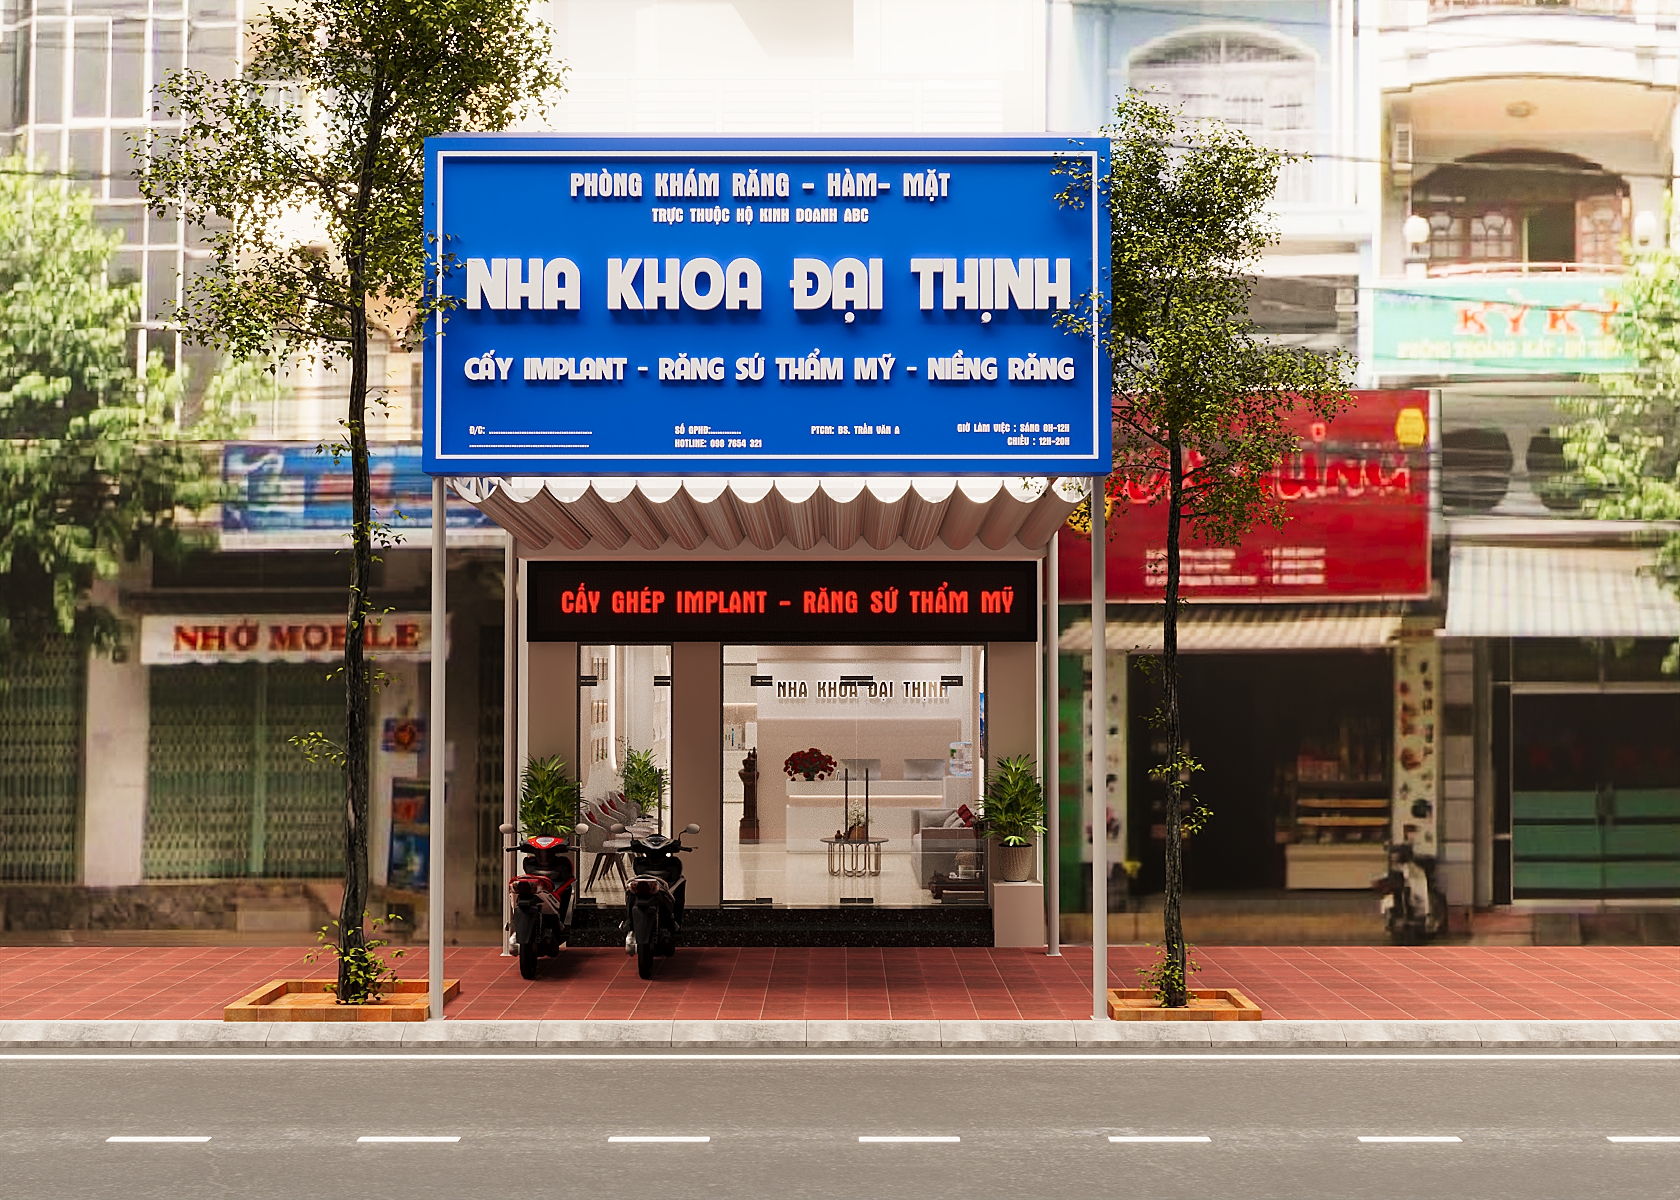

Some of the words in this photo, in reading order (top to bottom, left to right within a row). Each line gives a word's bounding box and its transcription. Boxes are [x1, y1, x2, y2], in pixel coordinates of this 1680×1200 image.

[570, 168, 643, 197] PHÒNG
[654, 168, 720, 197] KHÁM
[732, 168, 790, 197] RĂNG
[903, 168, 950, 202] MẶT
[652, 206, 684, 225] TRỰC
[690, 206, 730, 225] THUỘC
[736, 206, 754, 225] HỘ
[759, 207, 790, 223] KINH
[796, 207, 838, 223] DOANH
[844, 207, 869, 223] ABC
[464, 257, 581, 310] NHA
[607, 257, 762, 310] KHOA
[789, 257, 883, 324] ĐẠI
[910, 257, 1072, 324] THỊNH
[464, 349, 513, 381] CẤY
[523, 357, 628, 381] IMPLANT
[658, 352, 725, 381] RĂNG
[735, 352, 766, 381] SỨ
[775, 347, 844, 381] THẨM
[853, 352, 896, 381] MỸ
[927, 349, 998, 381] NIỀNG
[1007, 352, 1075, 381] RĂNG
[837, 425, 851, 435] BS.
[875, 424, 892, 435] VĂN
[894, 425, 901, 435] A
[674, 438, 708, 448] HOTLINE:
[749, 438, 763, 448] 321
[561, 582, 601, 614] CẤY
[611, 586, 665, 614] GHÉP
[676, 590, 768, 614] IMPLANT
[803, 587, 858, 614] RĂNG
[870, 586, 899, 614] SỨ
[909, 581, 969, 614] THẨM
[981, 585, 1014, 614] MỸ
[777, 681, 808, 698] NHA
